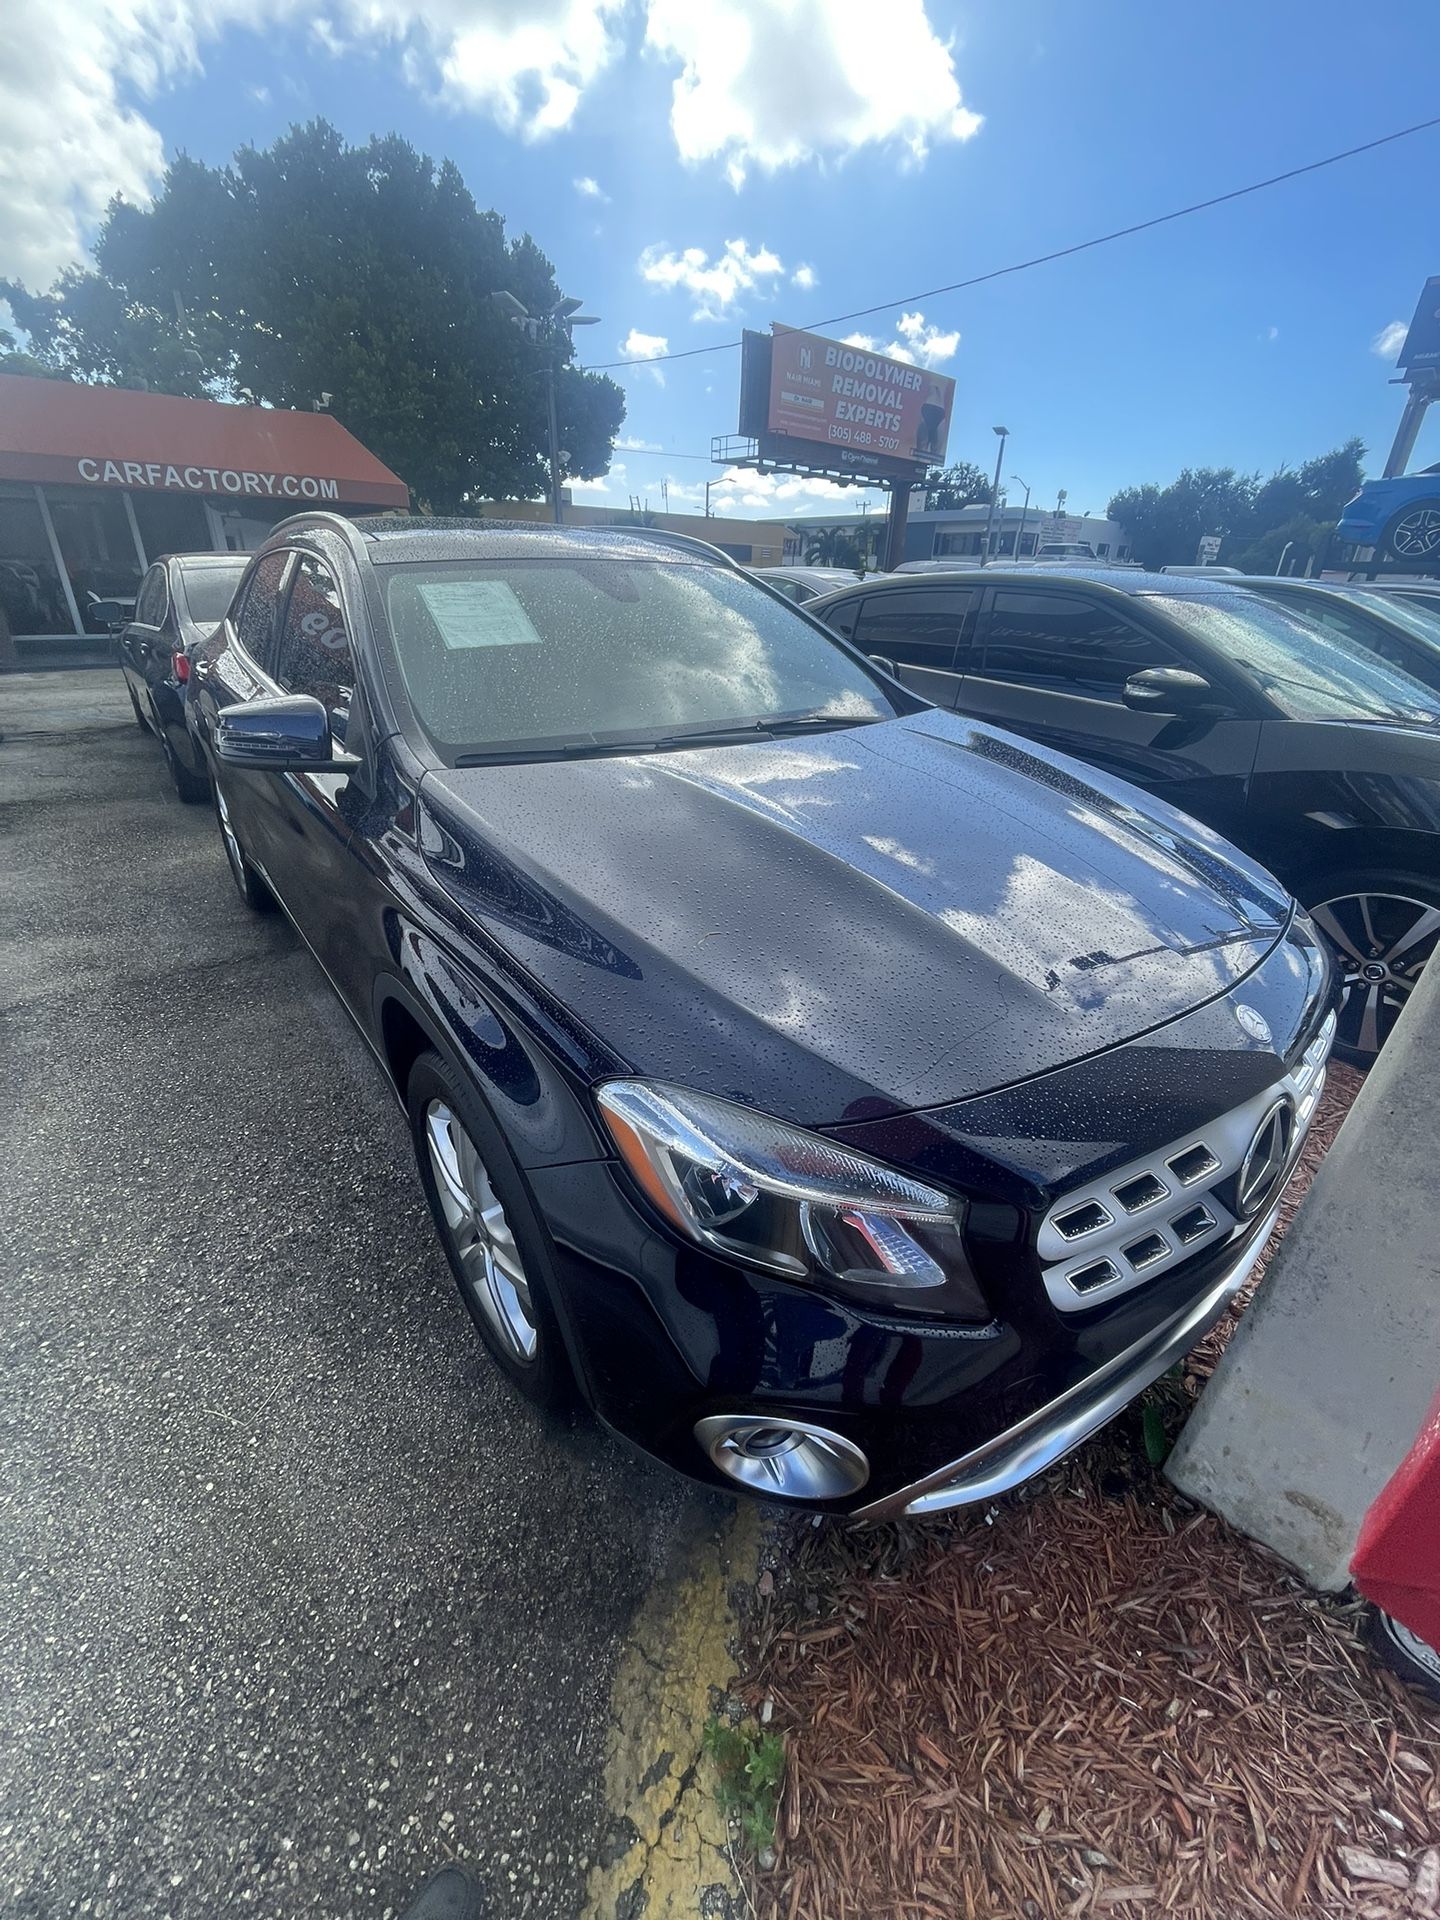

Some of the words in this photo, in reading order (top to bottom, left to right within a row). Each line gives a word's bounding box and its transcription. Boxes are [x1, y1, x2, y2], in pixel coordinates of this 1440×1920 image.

[825, 346, 922, 391] BIOPOLYMER
[831, 374, 904, 410] REMOVAL
[835, 400, 902, 432] EXPERTS
[828, 423, 852, 443] (305)
[853, 430, 872, 445] 488
[878, 435, 900, 450] 5707
[78, 457, 339, 500] CARFACTORY.COM
